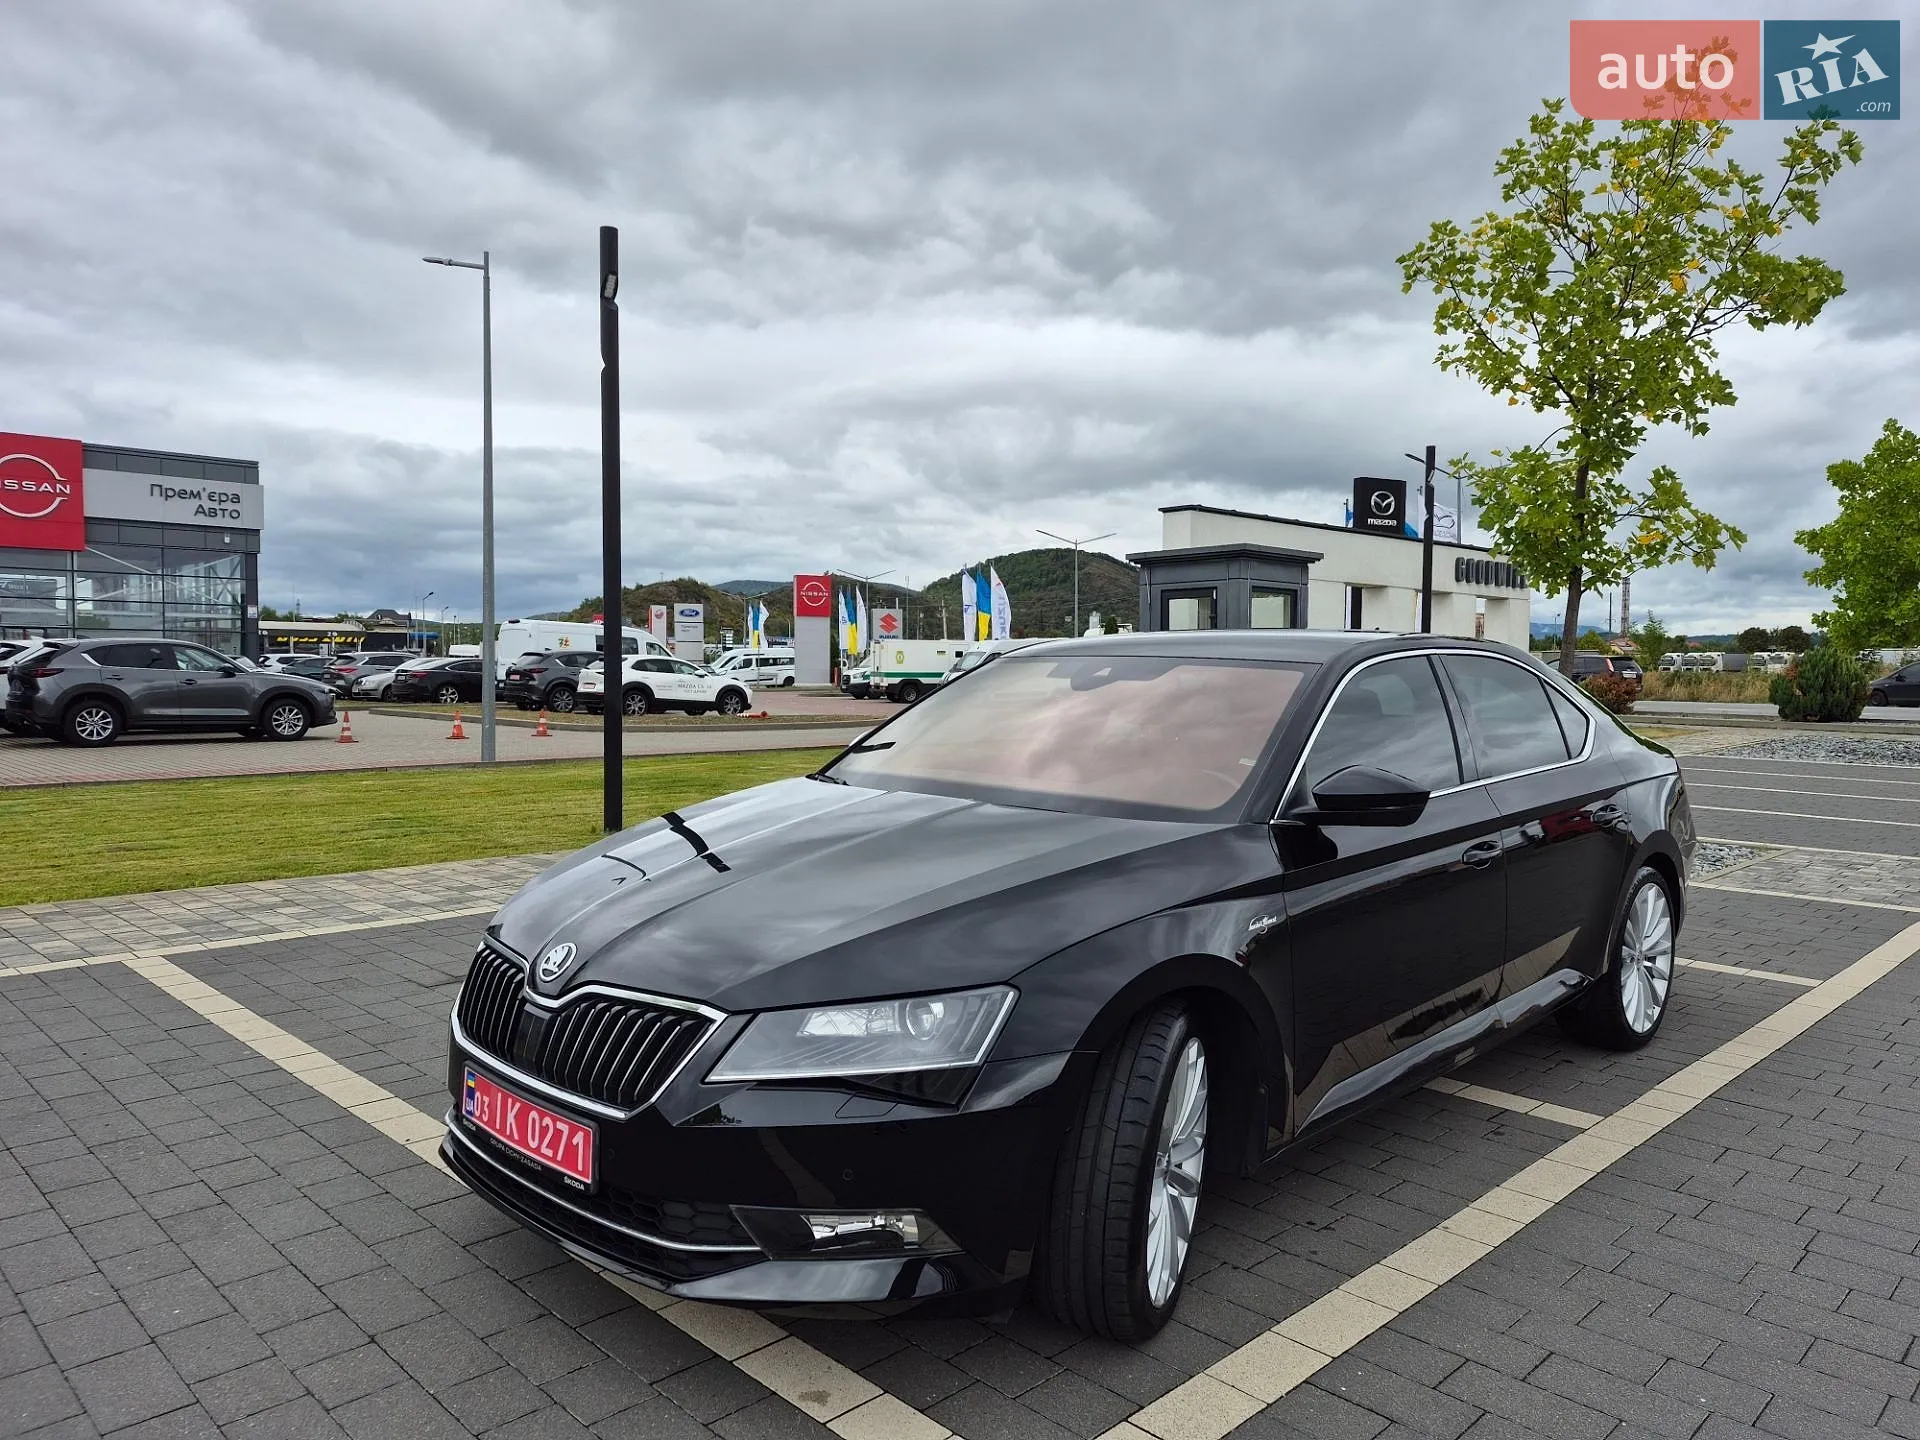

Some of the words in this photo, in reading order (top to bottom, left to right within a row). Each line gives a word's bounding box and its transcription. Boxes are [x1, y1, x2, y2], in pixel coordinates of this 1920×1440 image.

[150, 483, 241, 506] Прем'єра
[194, 503, 241, 520] Авто
[1367, 517, 1397, 527] mazda
[474, 1091, 490, 1123] 03
[495, 1092, 521, 1141] IK
[527, 1110, 584, 1172] 0271
